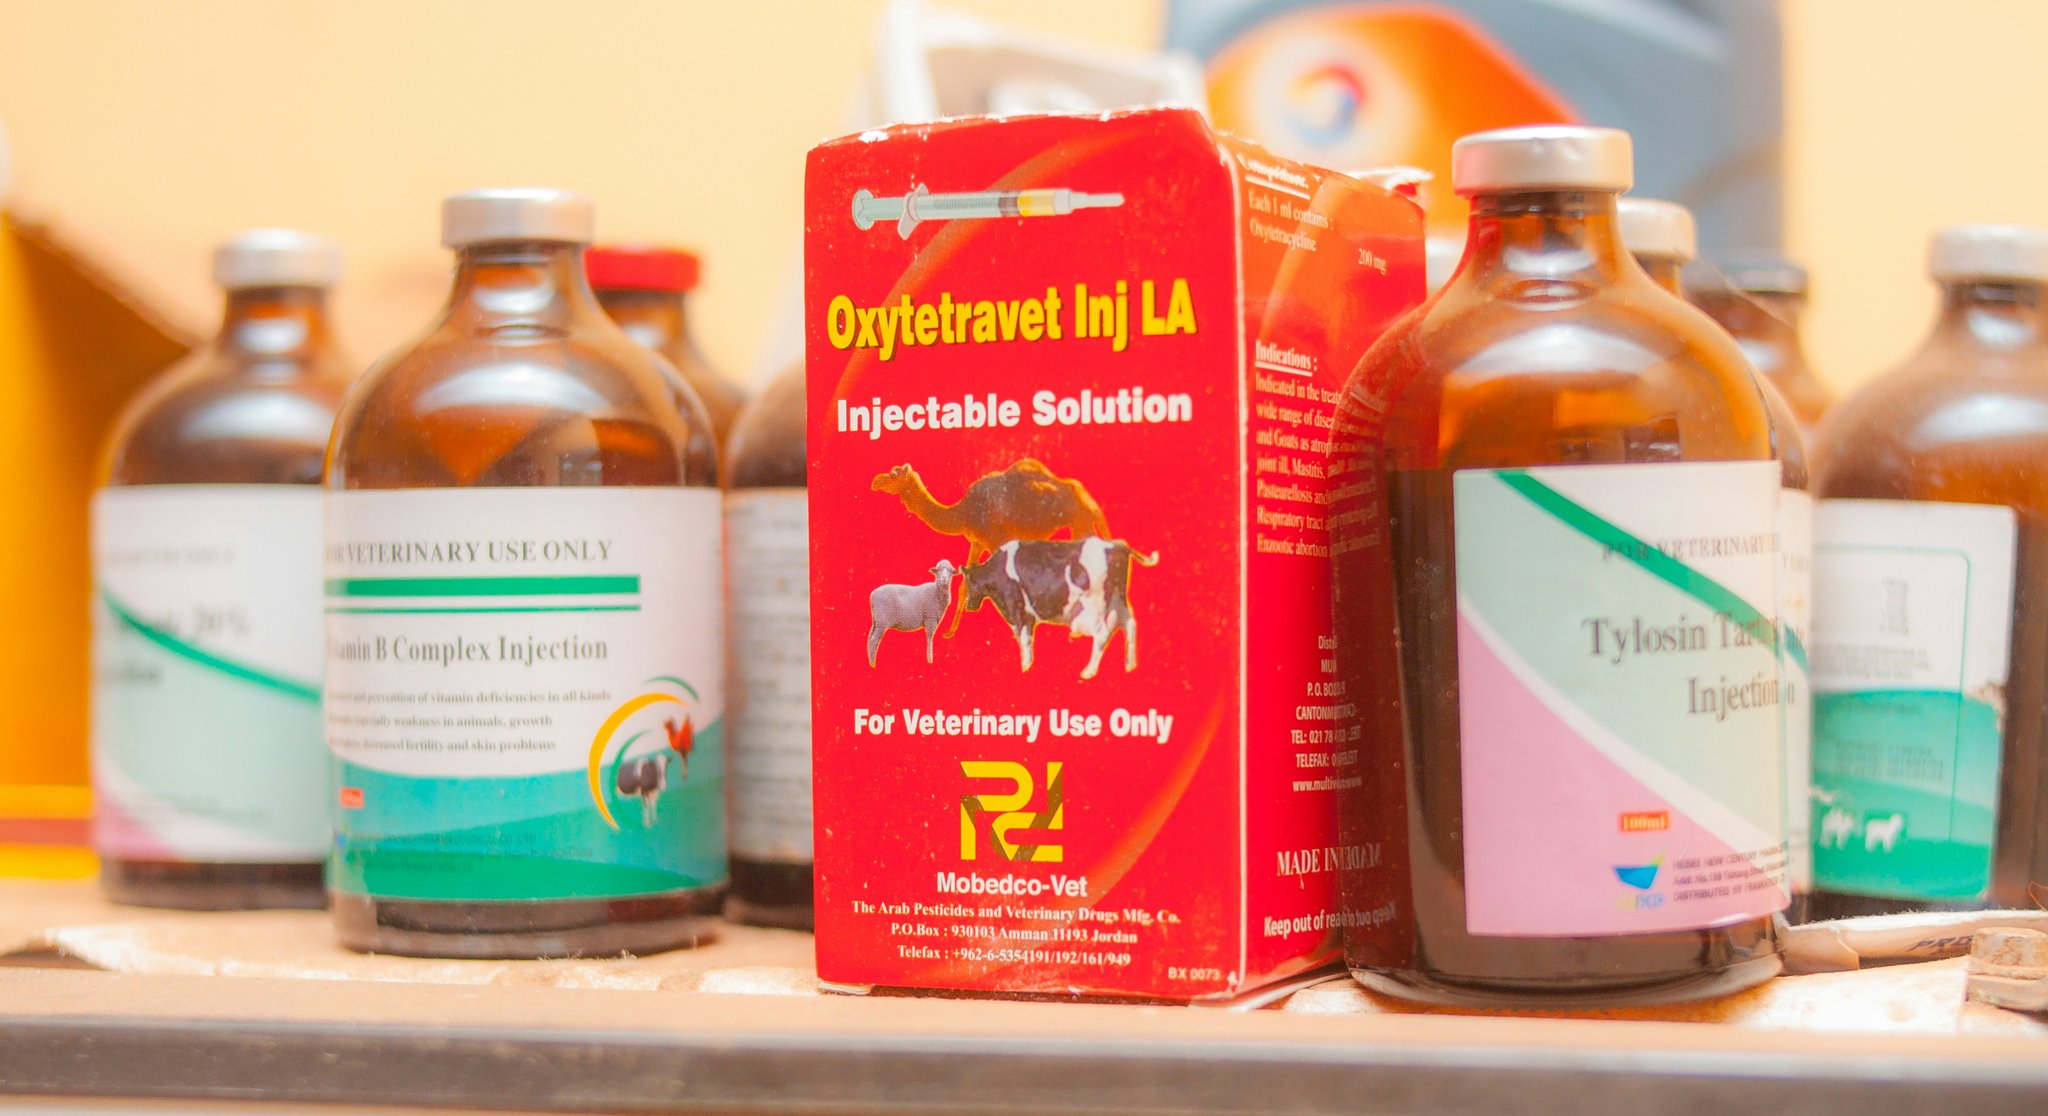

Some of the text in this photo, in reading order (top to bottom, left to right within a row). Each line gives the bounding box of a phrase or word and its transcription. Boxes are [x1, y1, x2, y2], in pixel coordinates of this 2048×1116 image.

[1248, 192, 1270, 213] Each
[1280, 202, 1292, 220] ml
[1293, 208, 1328, 229] contains
[1249, 217, 1317, 252] Oxytetracycline
[1358, 248, 1386, 275] 200 mg
[827, 278, 1197, 361] Oxytetravet Inj LA
[1256, 339, 1312, 370] Indications
[1256, 372, 1295, 397] Indicated
[1297, 379, 1305, 399] in
[1307, 383, 1319, 401] the
[837, 386, 1192, 440] Injectable Solution
[1256, 401, 1277, 420] wide
[1279, 407, 1302, 428] range
[1304, 409, 1313, 425] of
[1256, 428, 1272, 446] and
[1274, 428, 1298, 450] Goats
[1300, 437, 1309, 451] as
[1256, 452, 1325, 479] joint ill, Mastitis,
[1257, 479, 1329, 505] Pasteurellosis and
[1257, 504, 1323, 533] Respiratory tract
[347, 541, 480, 565] VETERINARY
[488, 540, 536, 562] USE
[543, 539, 613, 562] ONLY
[1257, 532, 1328, 558] Enzootic abortion
[1601, 543, 1649, 562] FOR
[1657, 534, 1765, 559] VETERINARY
[376, 636, 387, 661] B
[393, 635, 491, 667] Complex
[499, 635, 608, 666] Injection
[1581, 613, 1706, 665] Tylosin
[368, 690, 416, 704] prevention
[418, 691, 428, 703] of
[431, 691, 473, 703] vitamin
[476, 690, 546, 704] deficiencies
[549, 690, 559, 702] in
[562, 689, 577, 701] all
[579, 689, 611, 701] kinds
[1687, 671, 1779, 722] Injection
[393, 715, 441, 727] weakness
[443, 715, 451, 727] in
[509, 715, 553, 729] growth
[854, 708, 1173, 744] For Veterinary Use Only
[406, 738, 443, 753] fertility
[447, 739, 468, 750] and
[472, 738, 496, 751] skin
[500, 738, 556, 753] problems
[1291, 730, 1307, 744] TEL:
[1309, 730, 1322, 744] 021
[1296, 753, 1329, 767] TELEFAX:
[1623, 814, 1666, 830] 100ml
[1277, 847, 1339, 876] MADE IN
[1704, 854, 1723, 868] NEW
[937, 872, 1088, 898] Mobedco-Vet
[1673, 886, 1729, 902] DISTRIBUTED
[852, 900, 1181, 925] The Arab Pesticides and Veterinary Drugs Mfg. Co.
[1264, 915, 1291, 939] Keep
[1293, 913, 1312, 933] out
[1314, 909, 1325, 930] of
[891, 922, 939, 937] P.O.Box
[951, 924, 995, 939] 930103
[999, 926, 1048, 941] Amman
[1052, 928, 1088, 942] 11193
[1091, 929, 1138, 944] Jordan
[898, 944, 941, 959] Telefax
[952, 947, 1131, 966] +962-6-5354191/192/161/949
[1168, 966, 1220, 980] BX 0073
